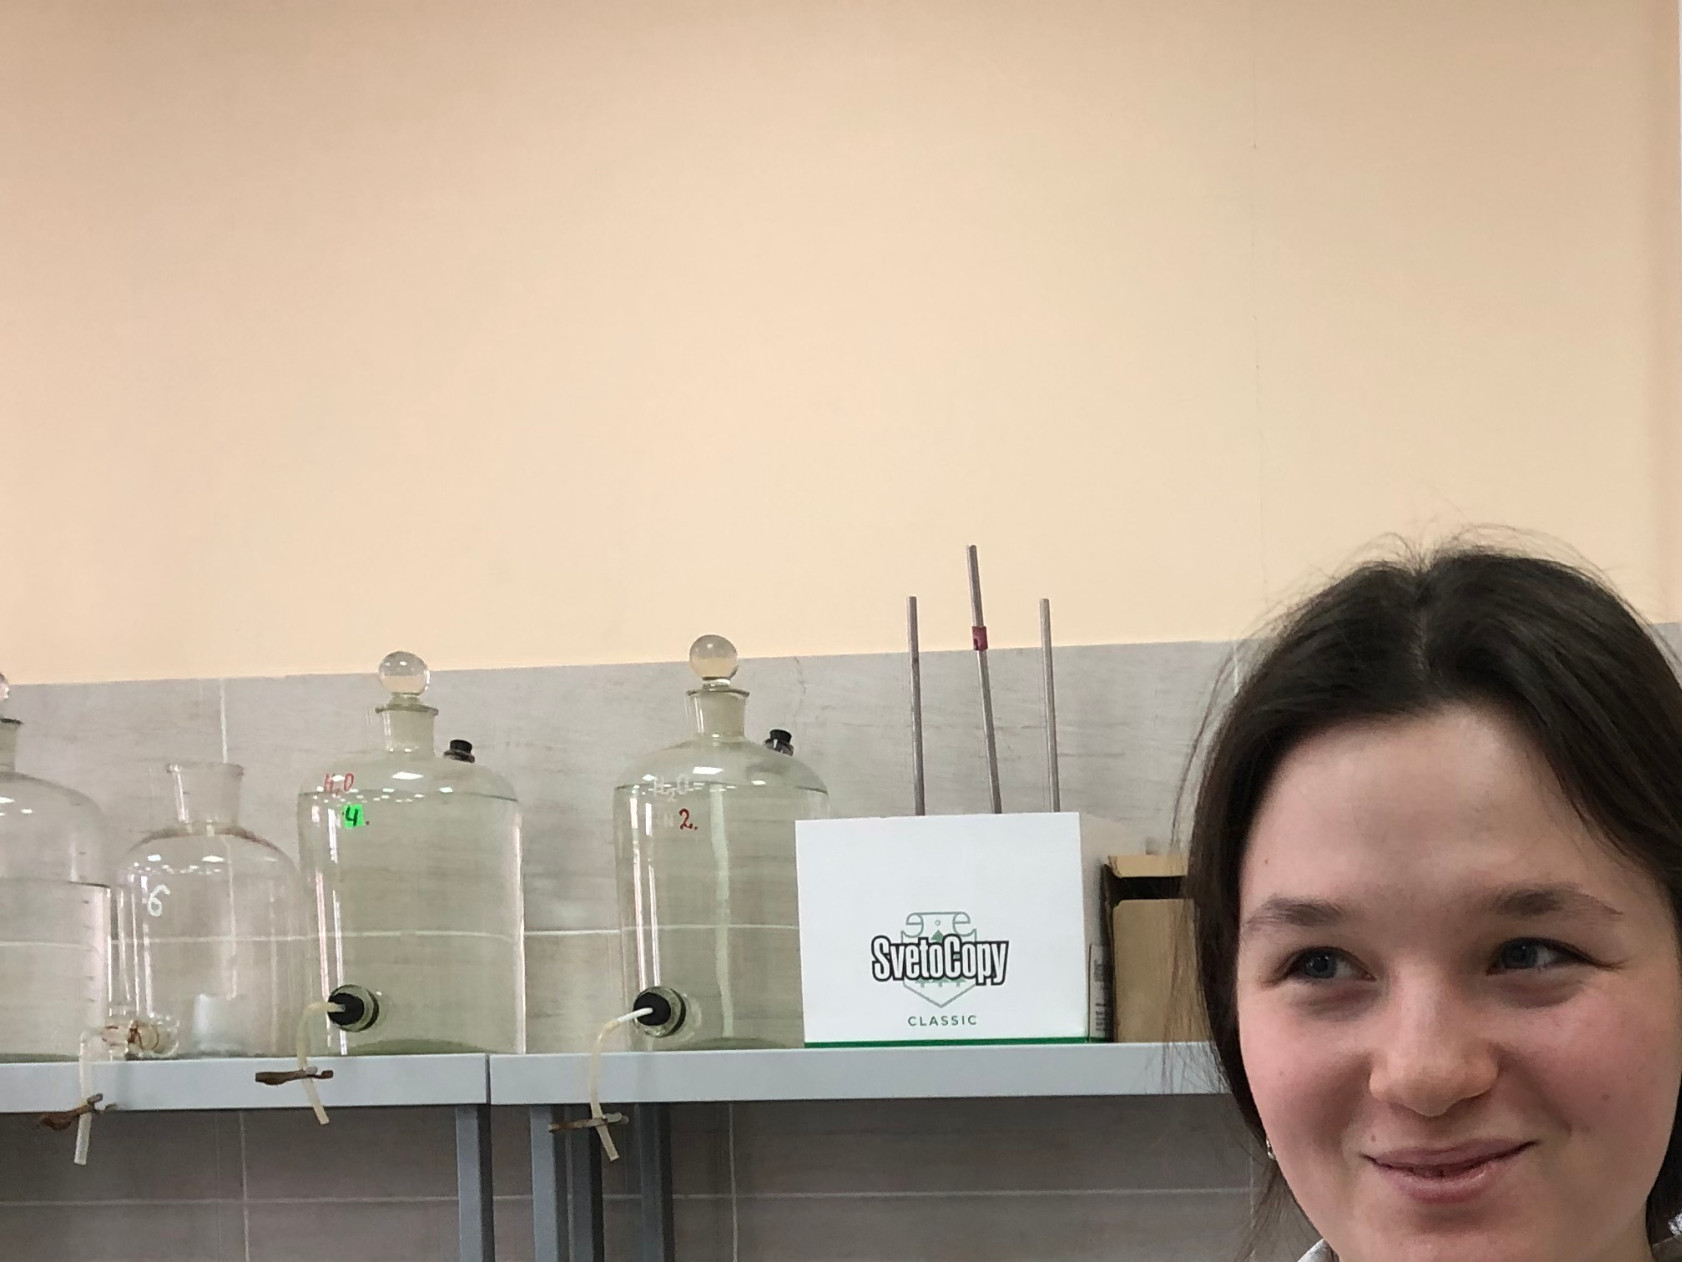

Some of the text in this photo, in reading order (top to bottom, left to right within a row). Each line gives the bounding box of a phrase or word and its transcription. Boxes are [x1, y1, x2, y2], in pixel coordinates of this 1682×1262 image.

[147, 884, 171, 917] 6
[871, 933, 1010, 987] SvetoCopy
[907, 1014, 978, 1027] CLASSIC
